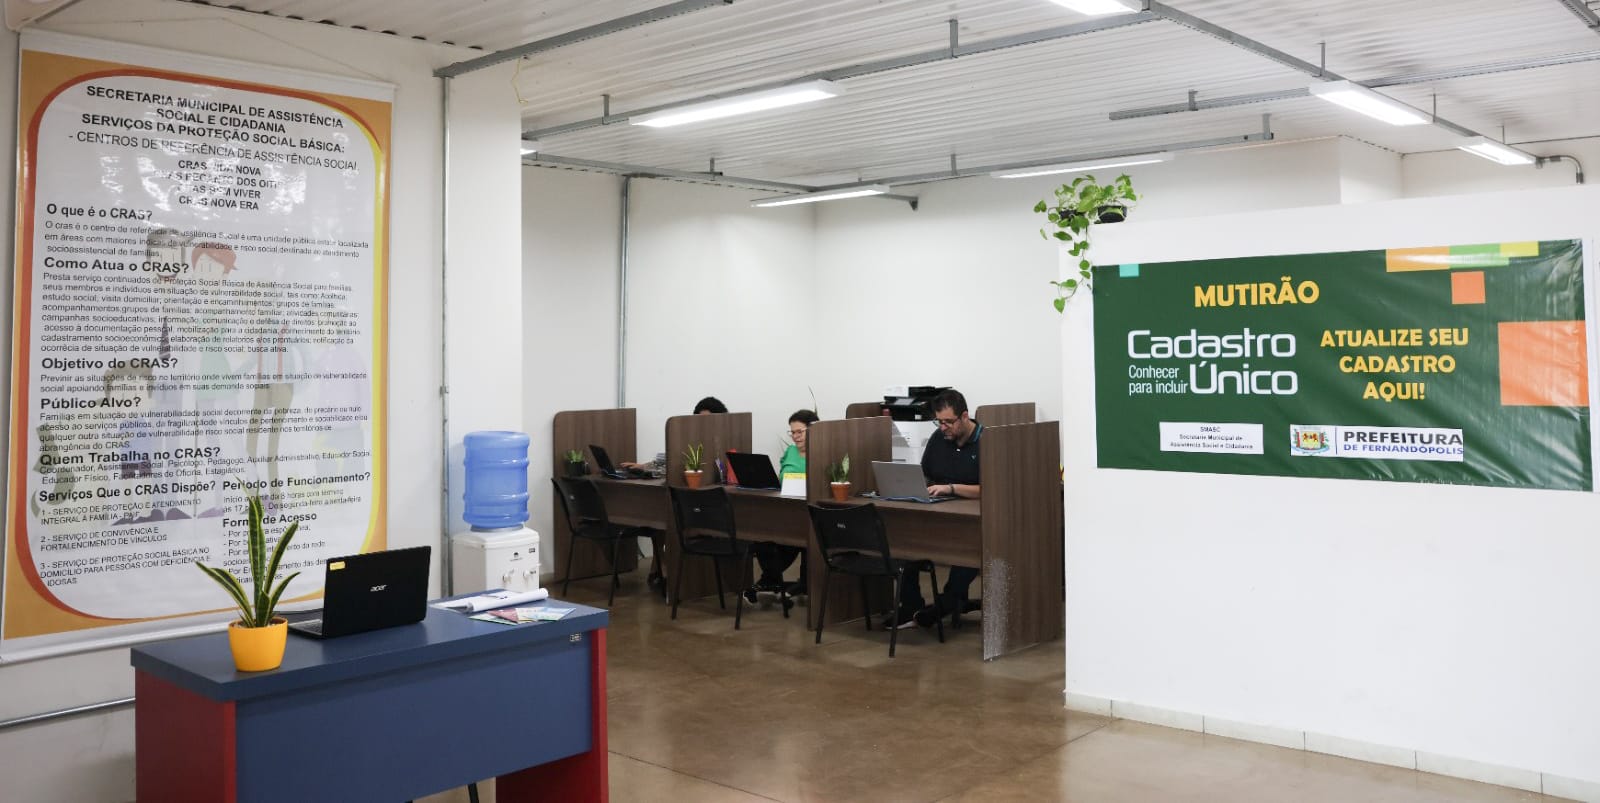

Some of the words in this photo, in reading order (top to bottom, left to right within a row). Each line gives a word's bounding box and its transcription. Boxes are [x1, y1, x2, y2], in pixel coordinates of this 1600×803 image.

[87, 86, 173, 106] SECRETARIA
[177, 98, 246, 115] MUNICIPAL
[249, 107, 264, 118] DE
[268, 110, 343, 128] ASSISTÊNCIA
[157, 108, 204, 123] SOCIAL
[208, 115, 216, 124] E
[220, 116, 286, 133] CIDADANIA
[82, 114, 153, 130] SERVIÇOS
[156, 123, 175, 133] DA
[179, 125, 249, 142] PROTEÇÃO
[253, 134, 296, 148] SOCIAL
[300, 138, 345, 153] BÁSICA:
[77, 131, 138, 147] CENTROS
[142, 138, 157, 149] DE
[237, 148, 251, 159] DE
[254, 150, 322, 166] ASSISTÊNCIA
[178, 160, 208, 170] CRAS
[236, 165, 262, 176] NOVA
[237, 177, 257, 187] DOS
[234, 189, 261, 199] VIVER
[47, 203, 57, 214] O
[61, 206, 84, 217] que
[88, 206, 95, 216] é
[99, 208, 106, 217] o
[110, 208, 152, 220] CRAS?
[211, 199, 237, 208] NOVA
[240, 201, 259, 211] ERA
[91, 224, 115, 232] centro
[106, 236, 136, 244] maiores
[44, 257, 88, 269] Como
[92, 259, 124, 271] Atua
[129, 262, 137, 271] o
[142, 261, 189, 274] CRAS?
[43, 272, 71, 281] Presta
[73, 273, 102, 283] serviço
[65, 284, 103, 292] membros
[1194, 276, 1320, 308] MUTIRÃO
[42, 314, 90, 323] campanhas
[84, 324, 142, 334] documentação
[41, 334, 103, 342] cadastramento
[1127, 328, 1296, 359] Cadastro
[1320, 328, 1423, 347] ATUALIZE
[1429, 328, 1468, 346] SEU
[81, 344, 92, 352] de
[95, 344, 128, 354] situação
[130, 344, 140, 352] de
[42, 358, 104, 372] Objetivo
[108, 357, 126, 369] do
[130, 358, 178, 369] CRAS?
[1339, 354, 1456, 373] CADASTRO
[1129, 365, 1179, 379] Conhecer
[1190, 361, 1299, 395] Único
[1129, 382, 1152, 396] para
[1155, 380, 1188, 394] incluir
[1363, 382, 1425, 402] AQUI!
[41, 398, 96, 409] Público
[100, 396, 141, 408] Alvo?
[93, 412, 126, 422] situação
[85, 422, 118, 431] serviços
[101, 431, 135, 440] situação
[1344, 431, 1463, 445] PREFEITURA
[40, 454, 83, 466] Quem
[88, 451, 149, 463] Trabalha
[154, 451, 170, 460] no
[174, 447, 220, 459] CRAS?
[42, 476, 82, 484] Educador
[271, 478, 284, 488] de
[287, 472, 371, 486] Funcionamento?
[40, 489, 92, 502] Serviços
[97, 487, 120, 498] Que
[124, 487, 131, 496] o
[135, 484, 168, 496] CRAS
[171, 480, 216, 494] Dispõe?
[53, 506, 87, 516] SERVIÇO
[263, 515, 276, 524] de
[279, 512, 317, 524] Acesso
[52, 532, 87, 543] SERVIÇO
[52, 558, 88, 570] SERVIÇO
[101, 552, 143, 563] PROTEÇÃO
[145, 549, 171, 558] SOCIAL
[84, 565, 103, 574] PARA
[106, 561, 140, 572] PESSOAS
[142, 559, 158, 568] COM
[47, 577, 77, 587] IDOSAS
[370, 584, 388, 592] acer
